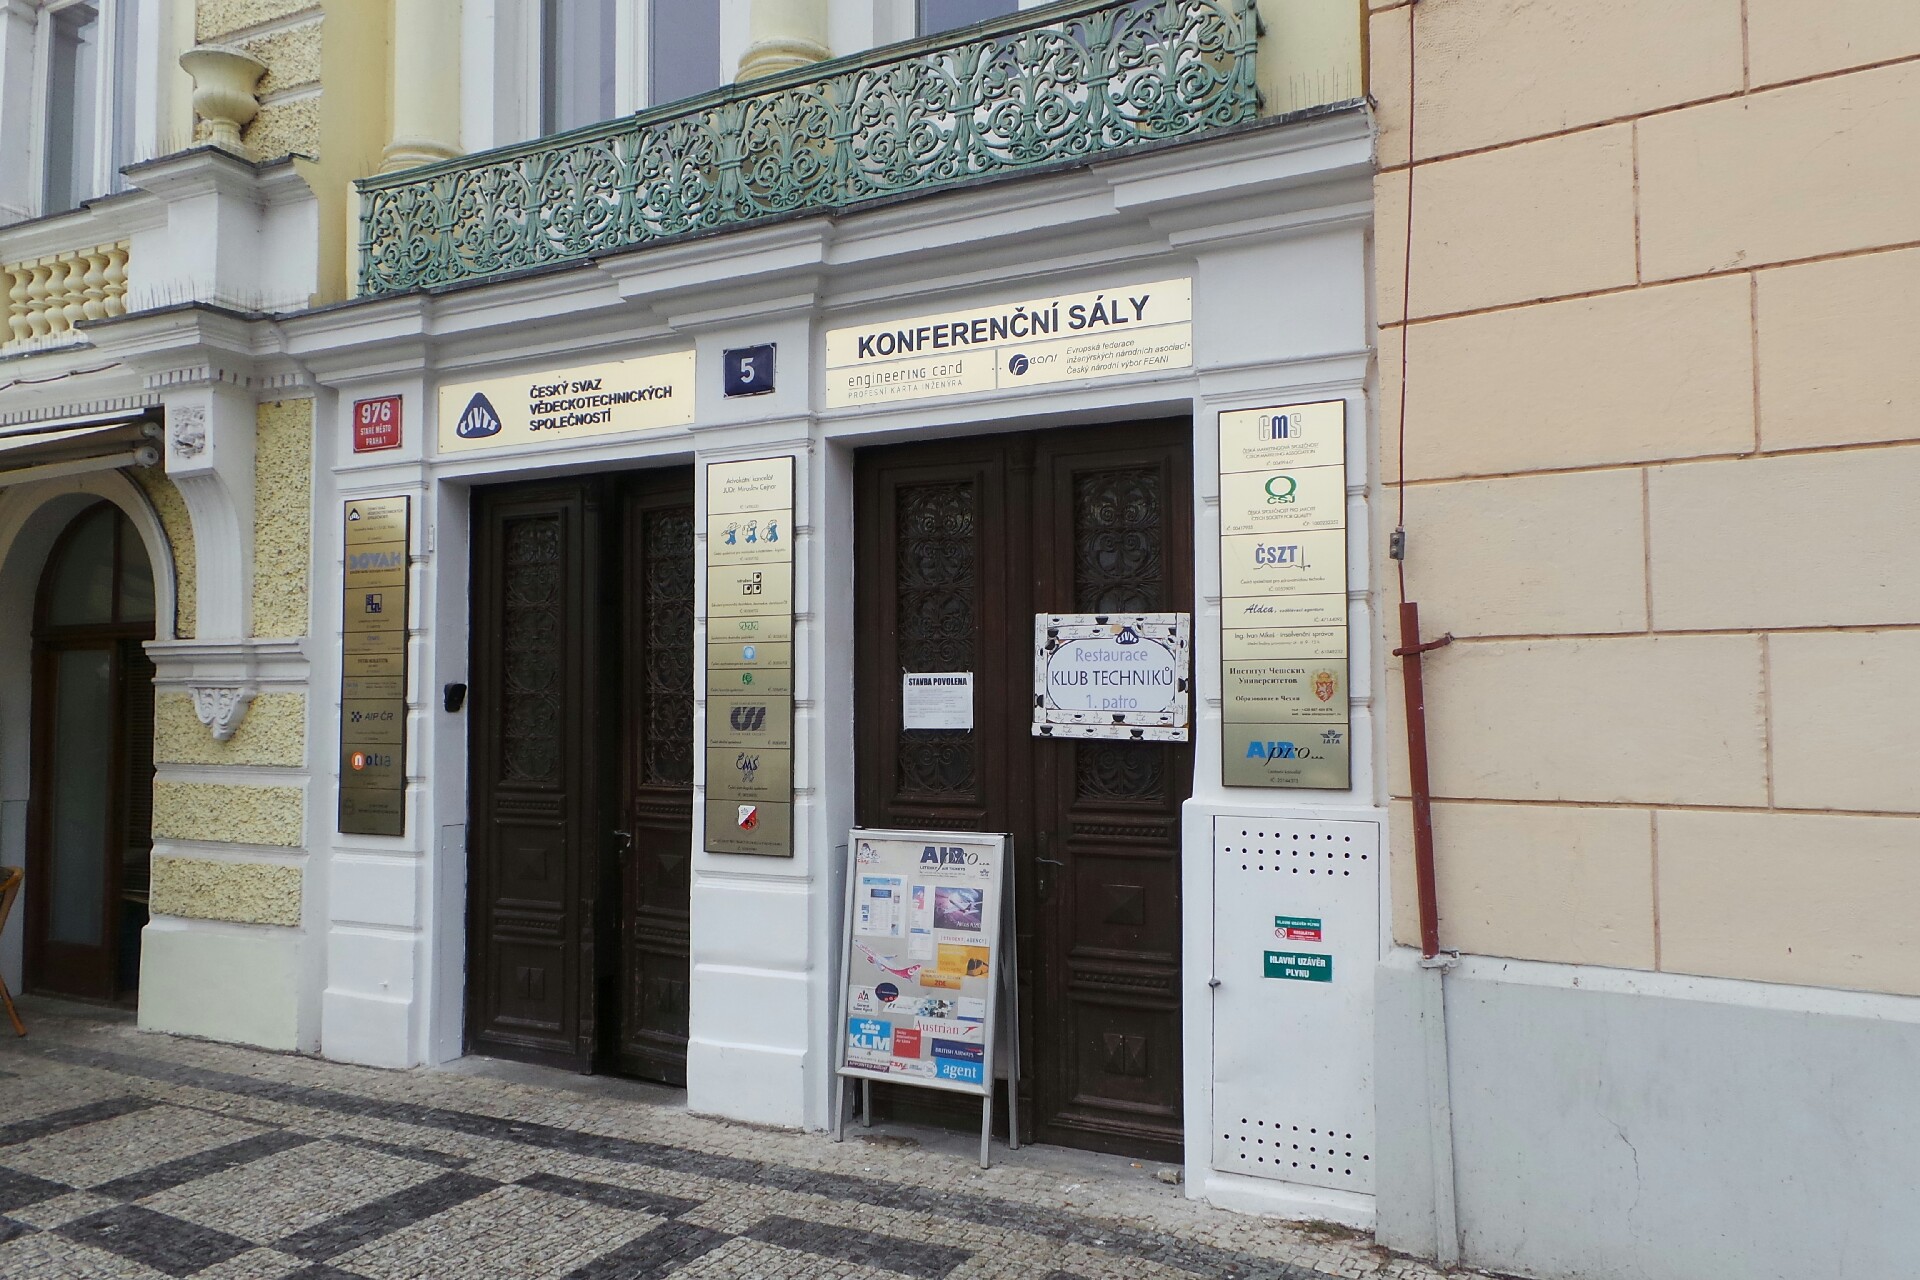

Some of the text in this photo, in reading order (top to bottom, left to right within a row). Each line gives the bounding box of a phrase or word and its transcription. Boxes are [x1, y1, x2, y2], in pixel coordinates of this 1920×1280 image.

[858, 295, 1150, 358] KONFERENČNÍ SÁLY
[740, 357, 755, 383] 5
[932, 360, 963, 376] card
[1066, 355, 1169, 375] Český národní výbor FEANI
[529, 378, 602, 399] ČESKÝ SVAZ
[848, 387, 887, 399] PROFESNÍ
[890, 384, 918, 394] KARTA
[529, 385, 673, 415] VĚDECKOTECHNICKÝCH
[361, 401, 391, 424] 976
[529, 408, 611, 431] SPOLEČNOSTÍ
[360, 423, 391, 436] STARÉ MĚSTO
[366, 437, 383, 446] PRAHA
[1255, 543, 1298, 564] ČSZT
[1075, 648, 1148, 662] Restaurace
[1051, 666, 1173, 686] KLUB TECHNIKŮ
[1229, 667, 1267, 676] Институт
[908, 677, 968, 686] STAVBA POVOLENA
[1238, 677, 1298, 686] Университетов
[1086, 694, 1138, 710] 1. patro
[364, 710, 394, 721] AIP ČR
[1269, 955, 1326, 967] HLAVNÍ UZÁVĚR
[1285, 968, 1310, 978] PLYNU
[914, 1019, 959, 1035] Austrian
[848, 1033, 890, 1051] KLM
[935, 1047, 954, 1055] BRITISH
[943, 1064, 977, 1079] agent
